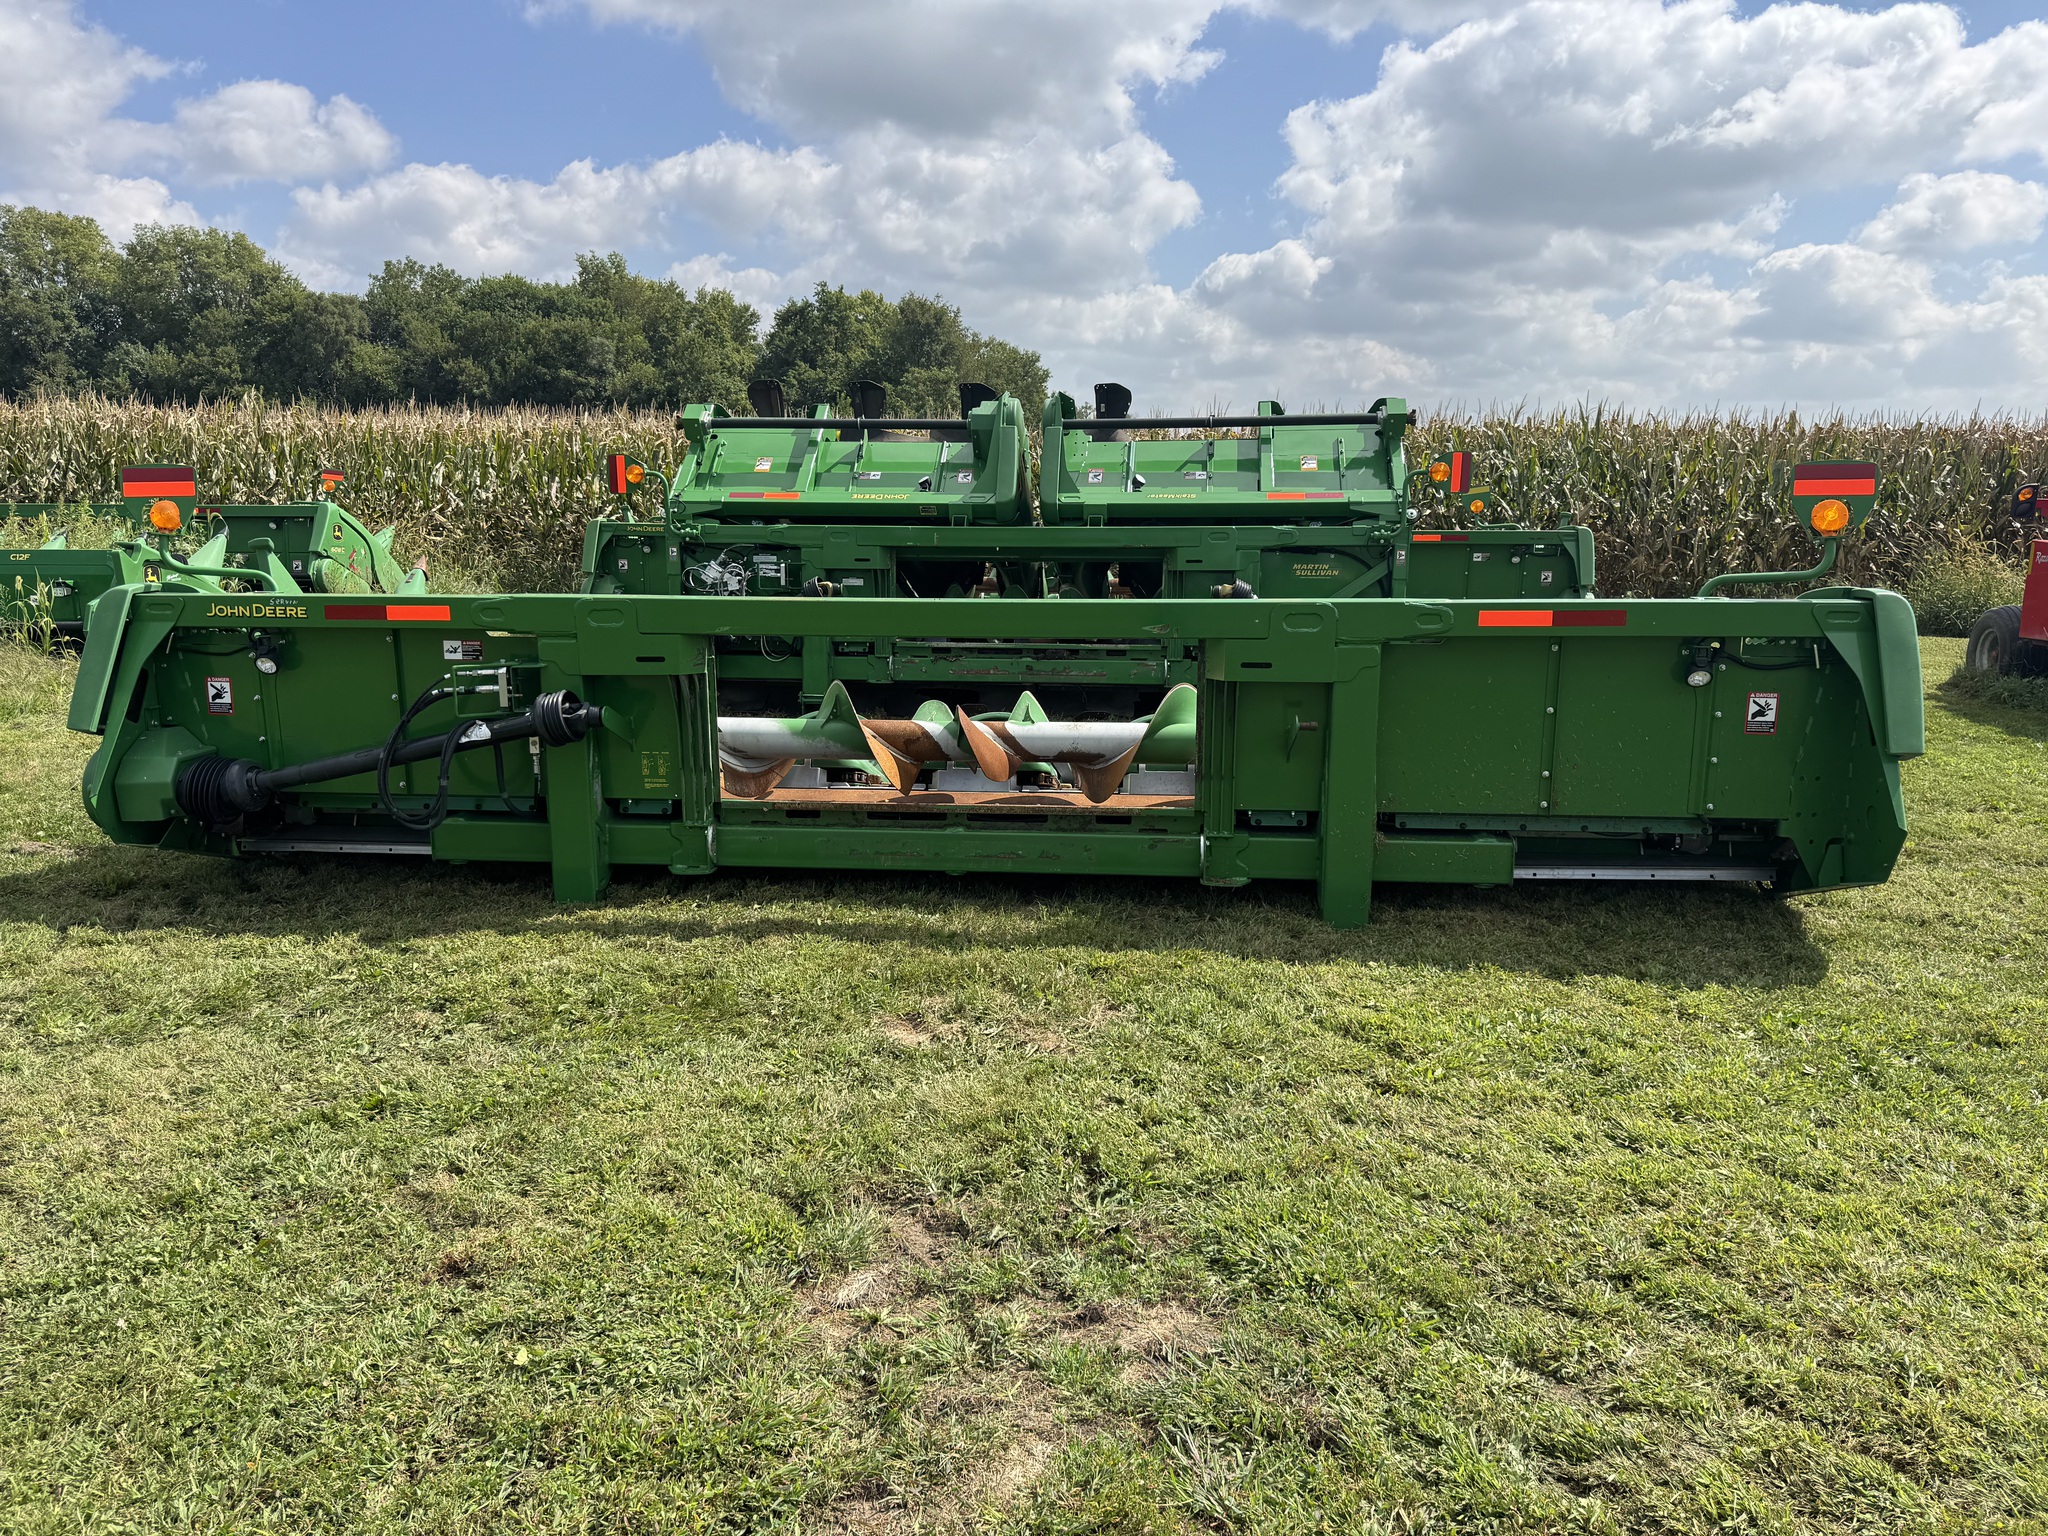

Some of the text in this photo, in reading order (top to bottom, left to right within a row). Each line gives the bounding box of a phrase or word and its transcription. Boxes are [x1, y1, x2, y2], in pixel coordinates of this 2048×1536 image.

[9, 553, 31, 561] C12F
[206, 602, 308, 618] JOHN DEERE
